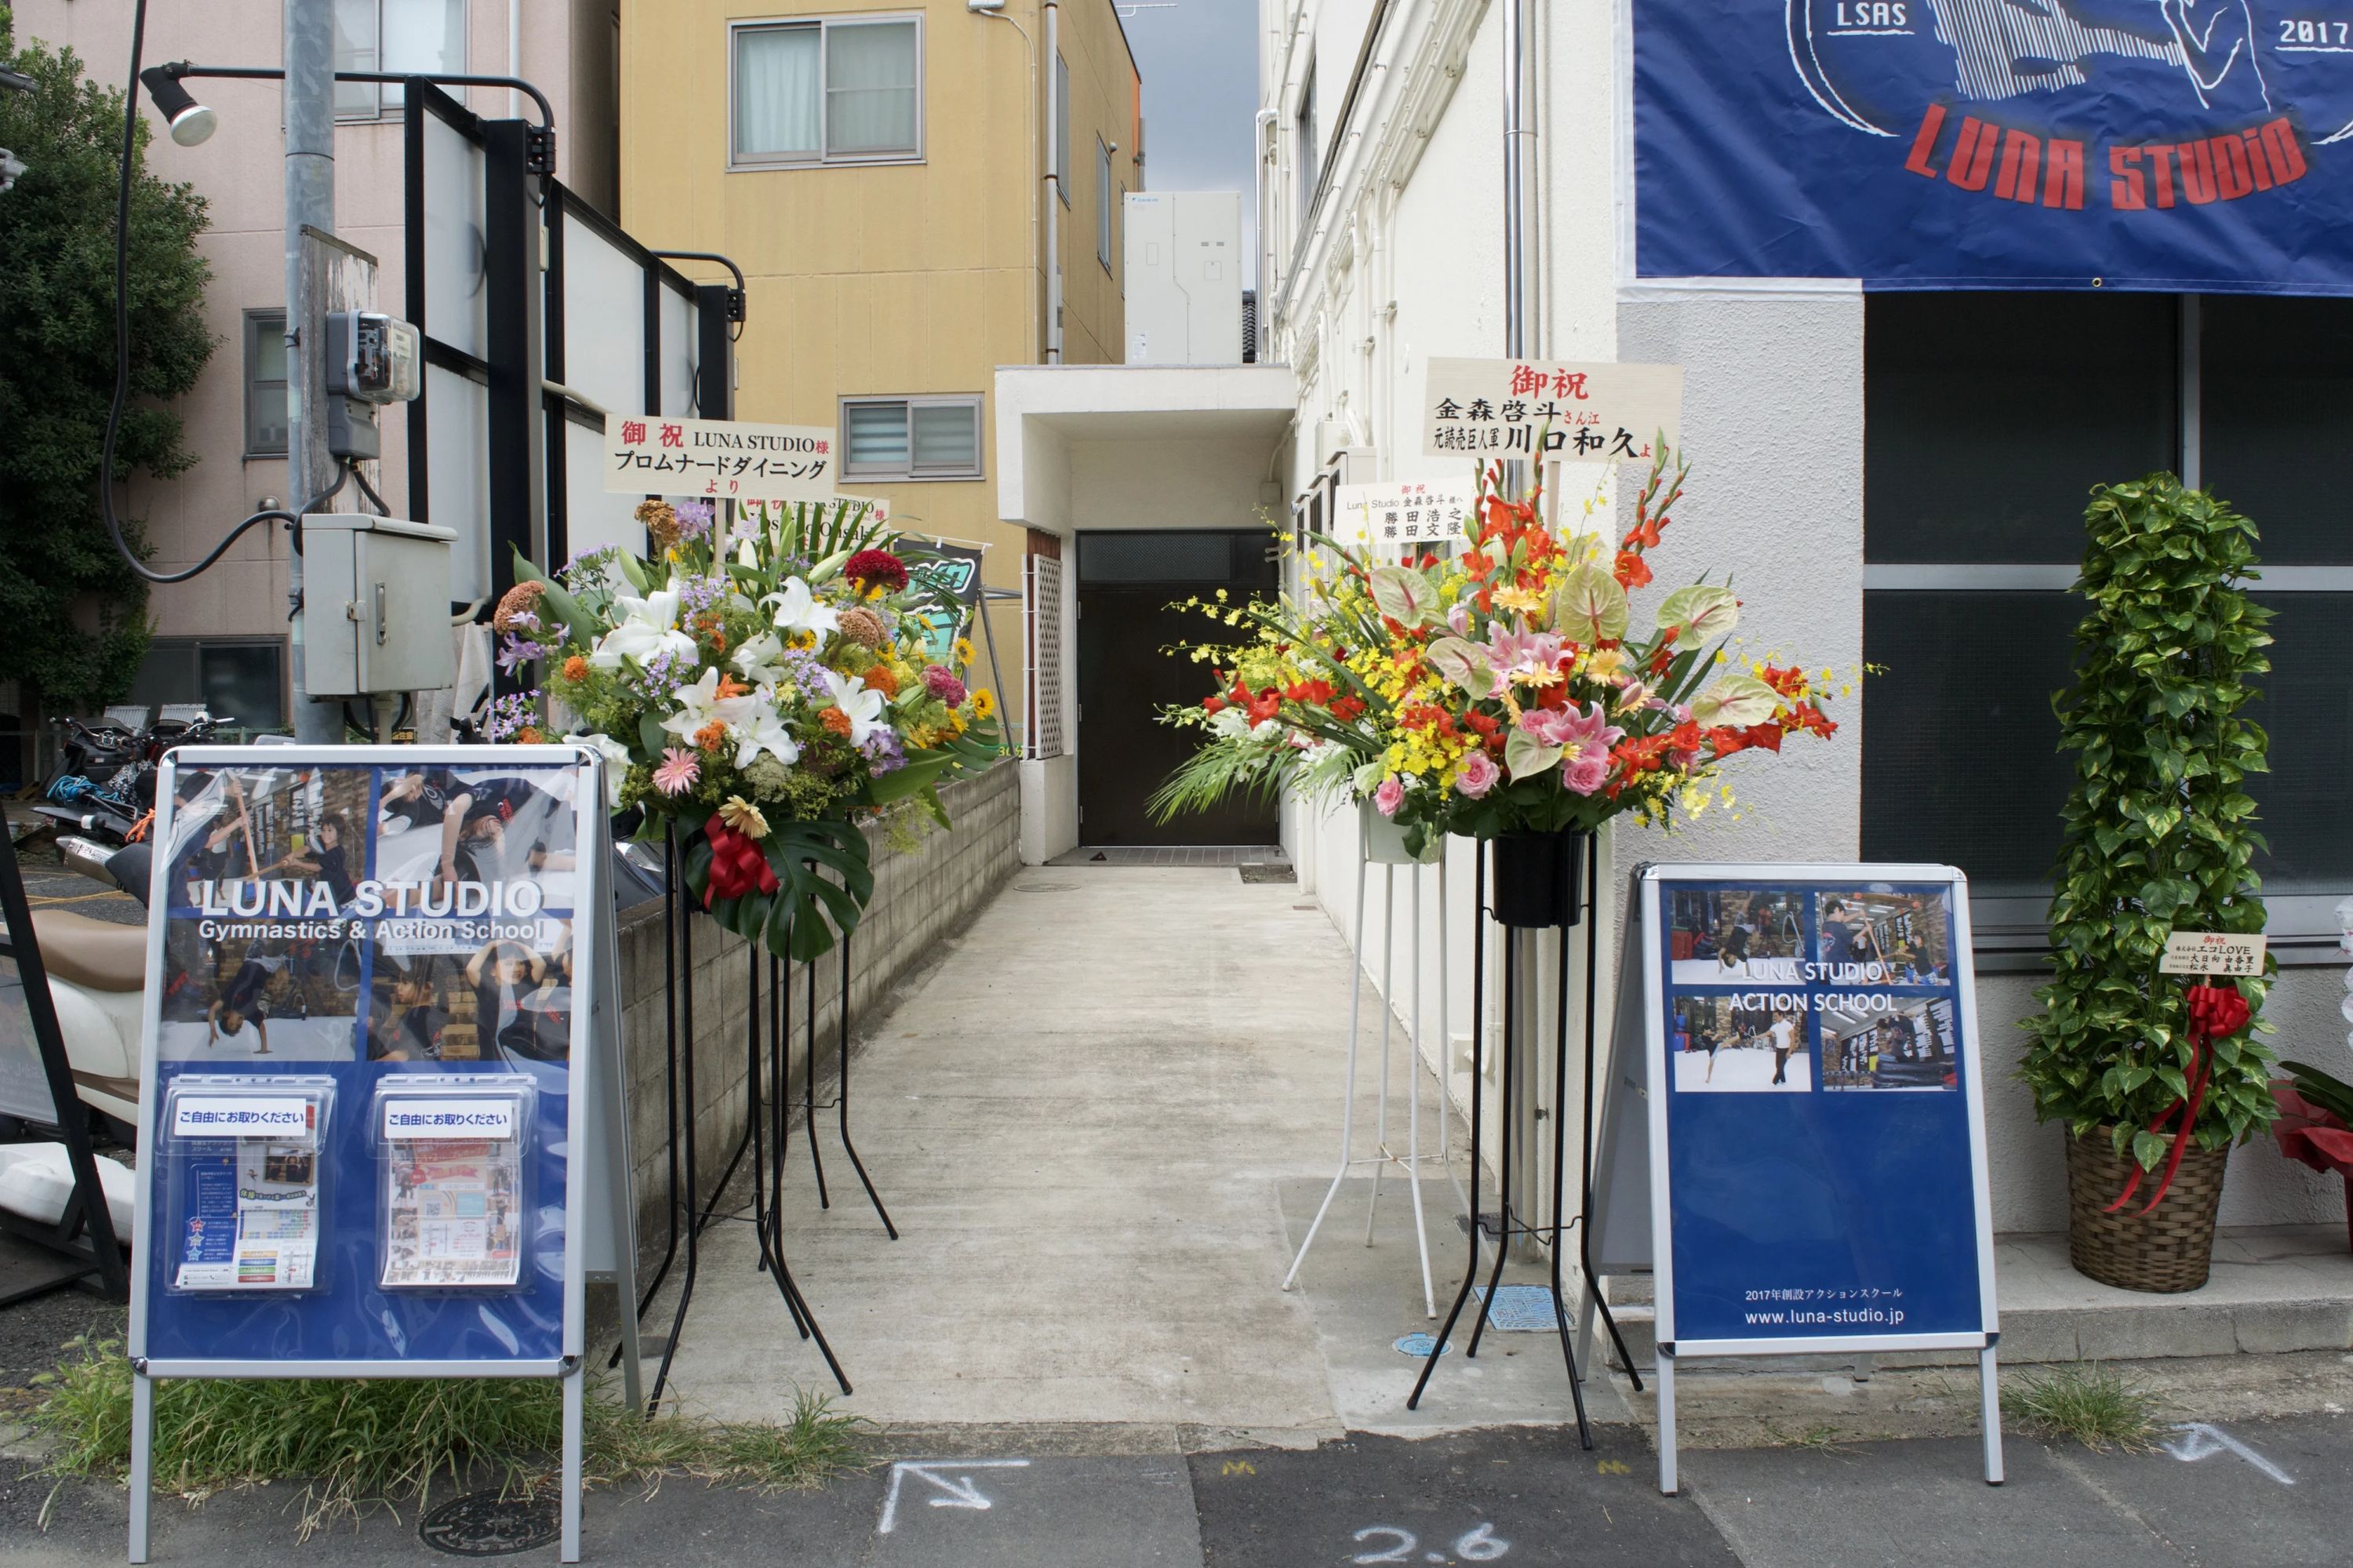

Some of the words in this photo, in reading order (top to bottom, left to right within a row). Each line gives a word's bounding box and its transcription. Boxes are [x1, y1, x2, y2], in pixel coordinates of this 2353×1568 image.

[1837, 2, 1907, 26] LSAS
[2279, 20, 2348, 44] 2017
[1904, 104, 2084, 210] LUNA
[2110, 117, 2307, 211] STUDIO
[1508, 364, 1589, 400] 御祝
[620, 420, 685, 449] 御祝
[693, 431, 744, 449] LUNA
[614, 449, 827, 480] プロムナードダイニング
[705, 478, 740, 494] より
[1401, 484, 1426, 495] 御祝
[1371, 499, 1400, 510] Studio
[202, 880, 340, 918] LUNA
[355, 879, 541, 919] STUDIO
[198, 919, 342, 941] Gymnastics
[349, 920, 366, 939] &
[375, 919, 453, 940] Action
[460, 919, 541, 939] School
[1743, 962, 1800, 981] LUNA
[1805, 962, 1882, 982] STUDIO
[1728, 992, 1808, 1012] ACTION
[1813, 993, 1898, 1012] SCHOOL
[180, 1111, 304, 1124] ご自由にお取りください
[389, 1114, 507, 1126] ご自由にお取りください
[1745, 1287, 1903, 1301] 2017年創設アクションスクール
[1745, 1307, 1905, 1325] www.luna-studio.jp
